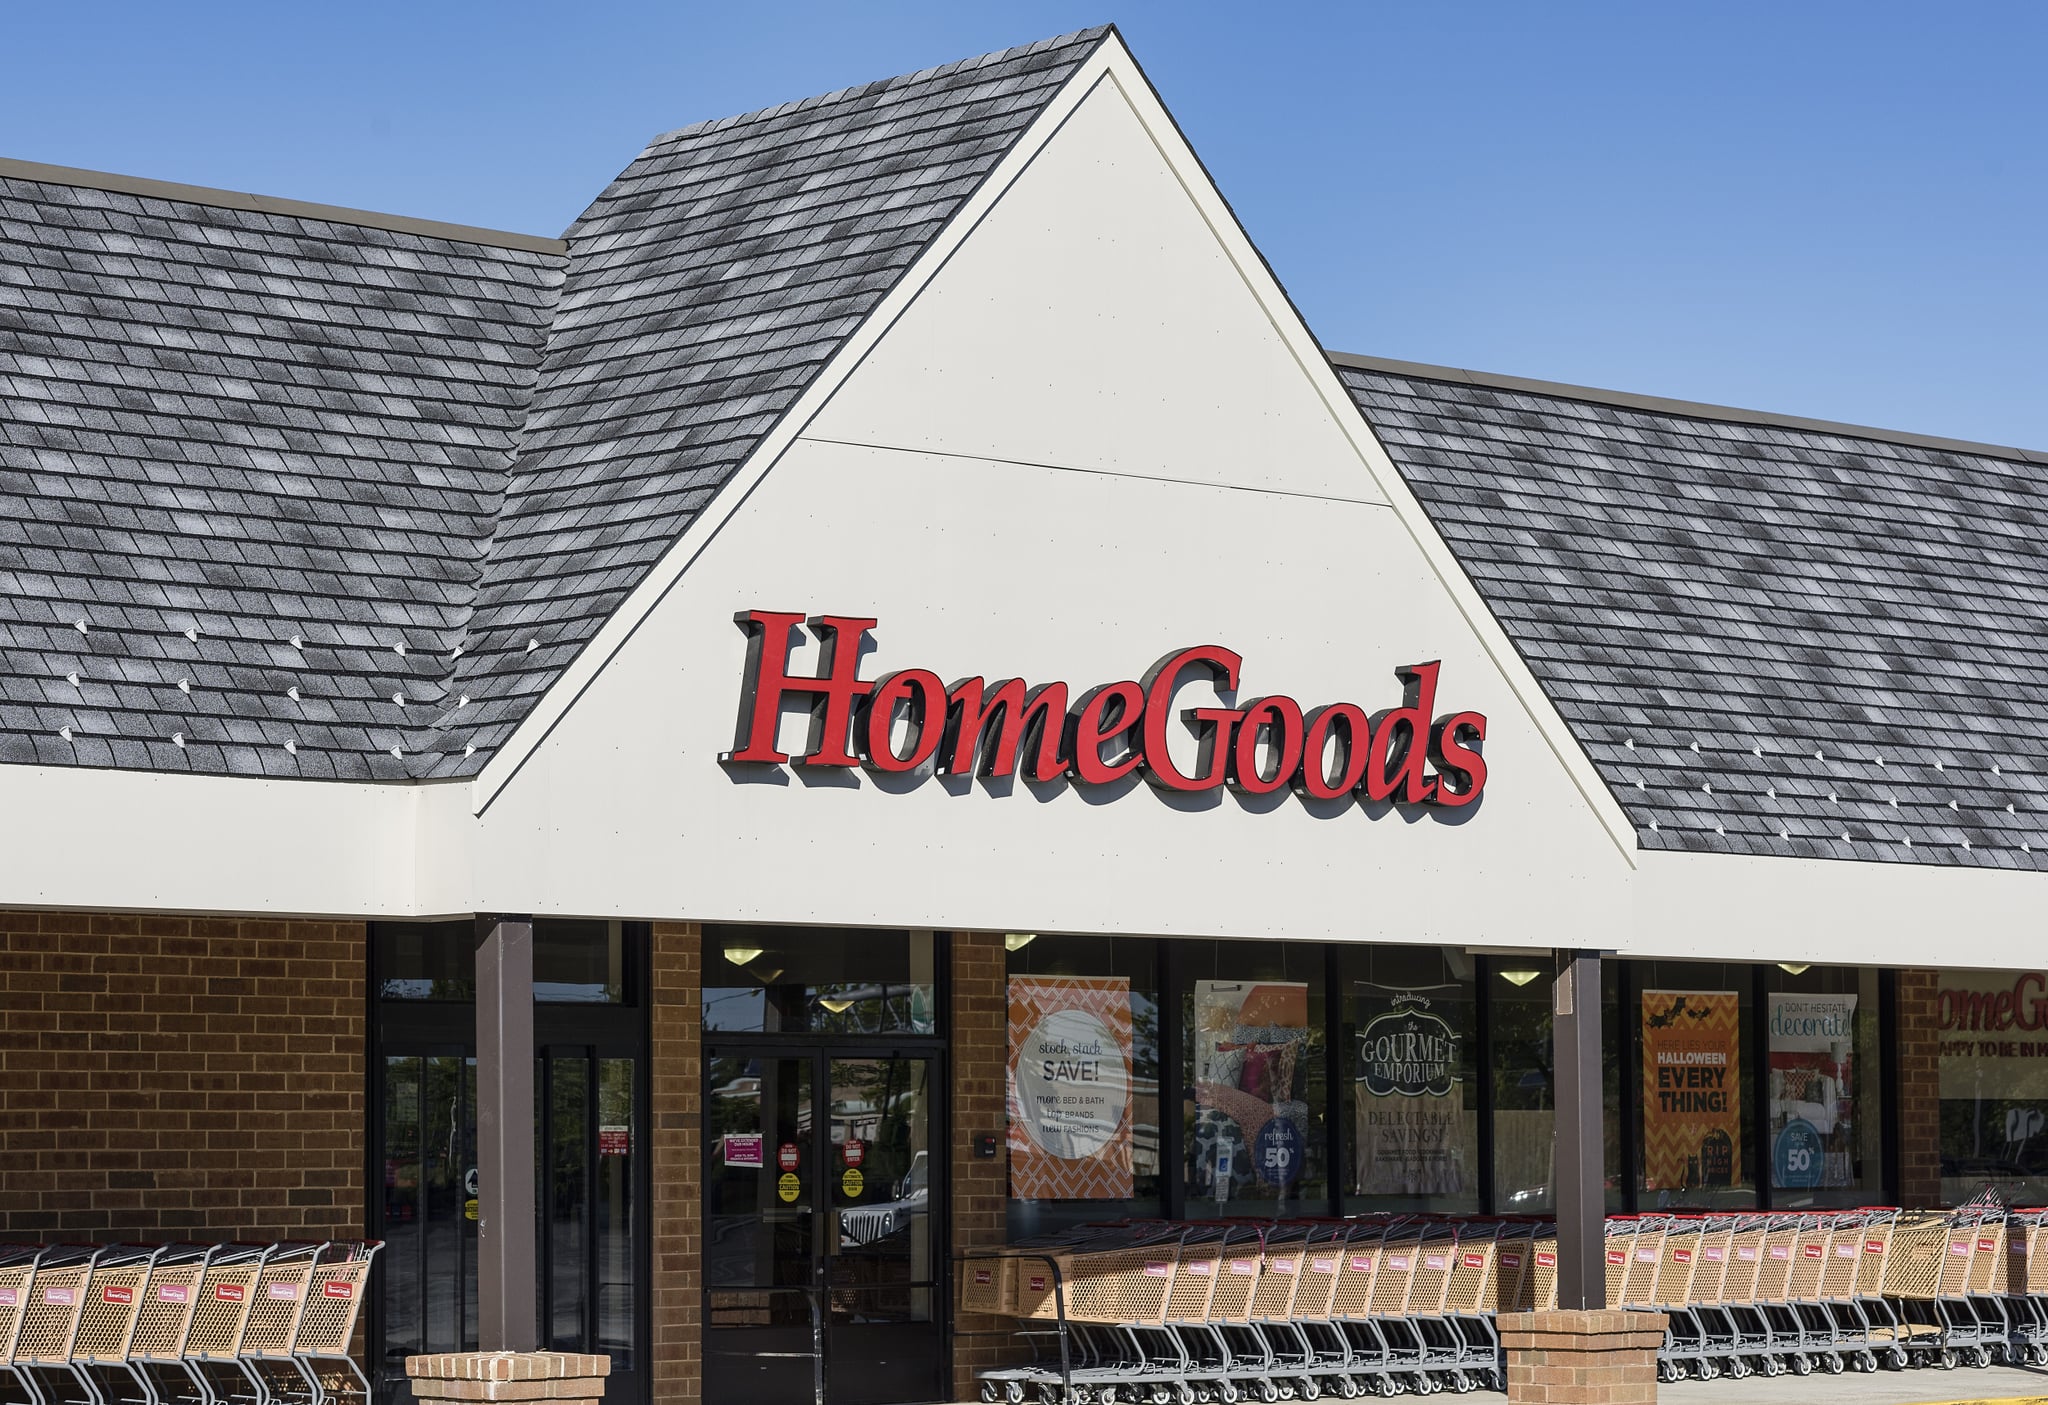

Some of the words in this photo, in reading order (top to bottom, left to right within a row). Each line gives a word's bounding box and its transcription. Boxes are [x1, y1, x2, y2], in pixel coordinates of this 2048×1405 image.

[720, 609, 1487, 808] HomeGoods
[1390, 991, 1432, 1009] introducing
[1785, 1003, 1809, 1012] DON'T
[1811, 1003, 1847, 1013] HESITATE
[1407, 1021, 1419, 1031] the
[1771, 1004, 1851, 1036] decorate!
[1038, 1039, 1071, 1056] stock,
[1072, 1039, 1103, 1056] stack
[1361, 1032, 1457, 1063] GOURMET
[1657, 1040, 1680, 1050] HERE
[1682, 1040, 1701, 1050] LIES
[1703, 1040, 1726, 1050] YOUR
[1977, 1041, 1997, 1057] TO
[1999, 1041, 2018, 1057] BE
[2020, 1041, 2035, 1057] IN
[1657, 1052, 1727, 1065] HALLOWEEN
[1042, 1060, 1100, 1081] SAVE!
[1374, 1062, 1445, 1084] EMPORIUM
[1658, 1066, 1727, 1088] EVERY
[1036, 1095, 1062, 1104] more
[1063, 1096, 1078, 1104] BED
[1658, 1091, 1728, 1113] THING!
[1046, 1108, 1062, 1122] top
[1064, 1110, 1095, 1119] BRANDS
[1368, 1111, 1455, 1126] DELECTABLE
[1042, 1125, 1062, 1133] new
[1063, 1125, 1100, 1133] FASHIONS
[1382, 1127, 1444, 1144] SAVINGS!
[1790, 1132, 1809, 1142] SAVE
